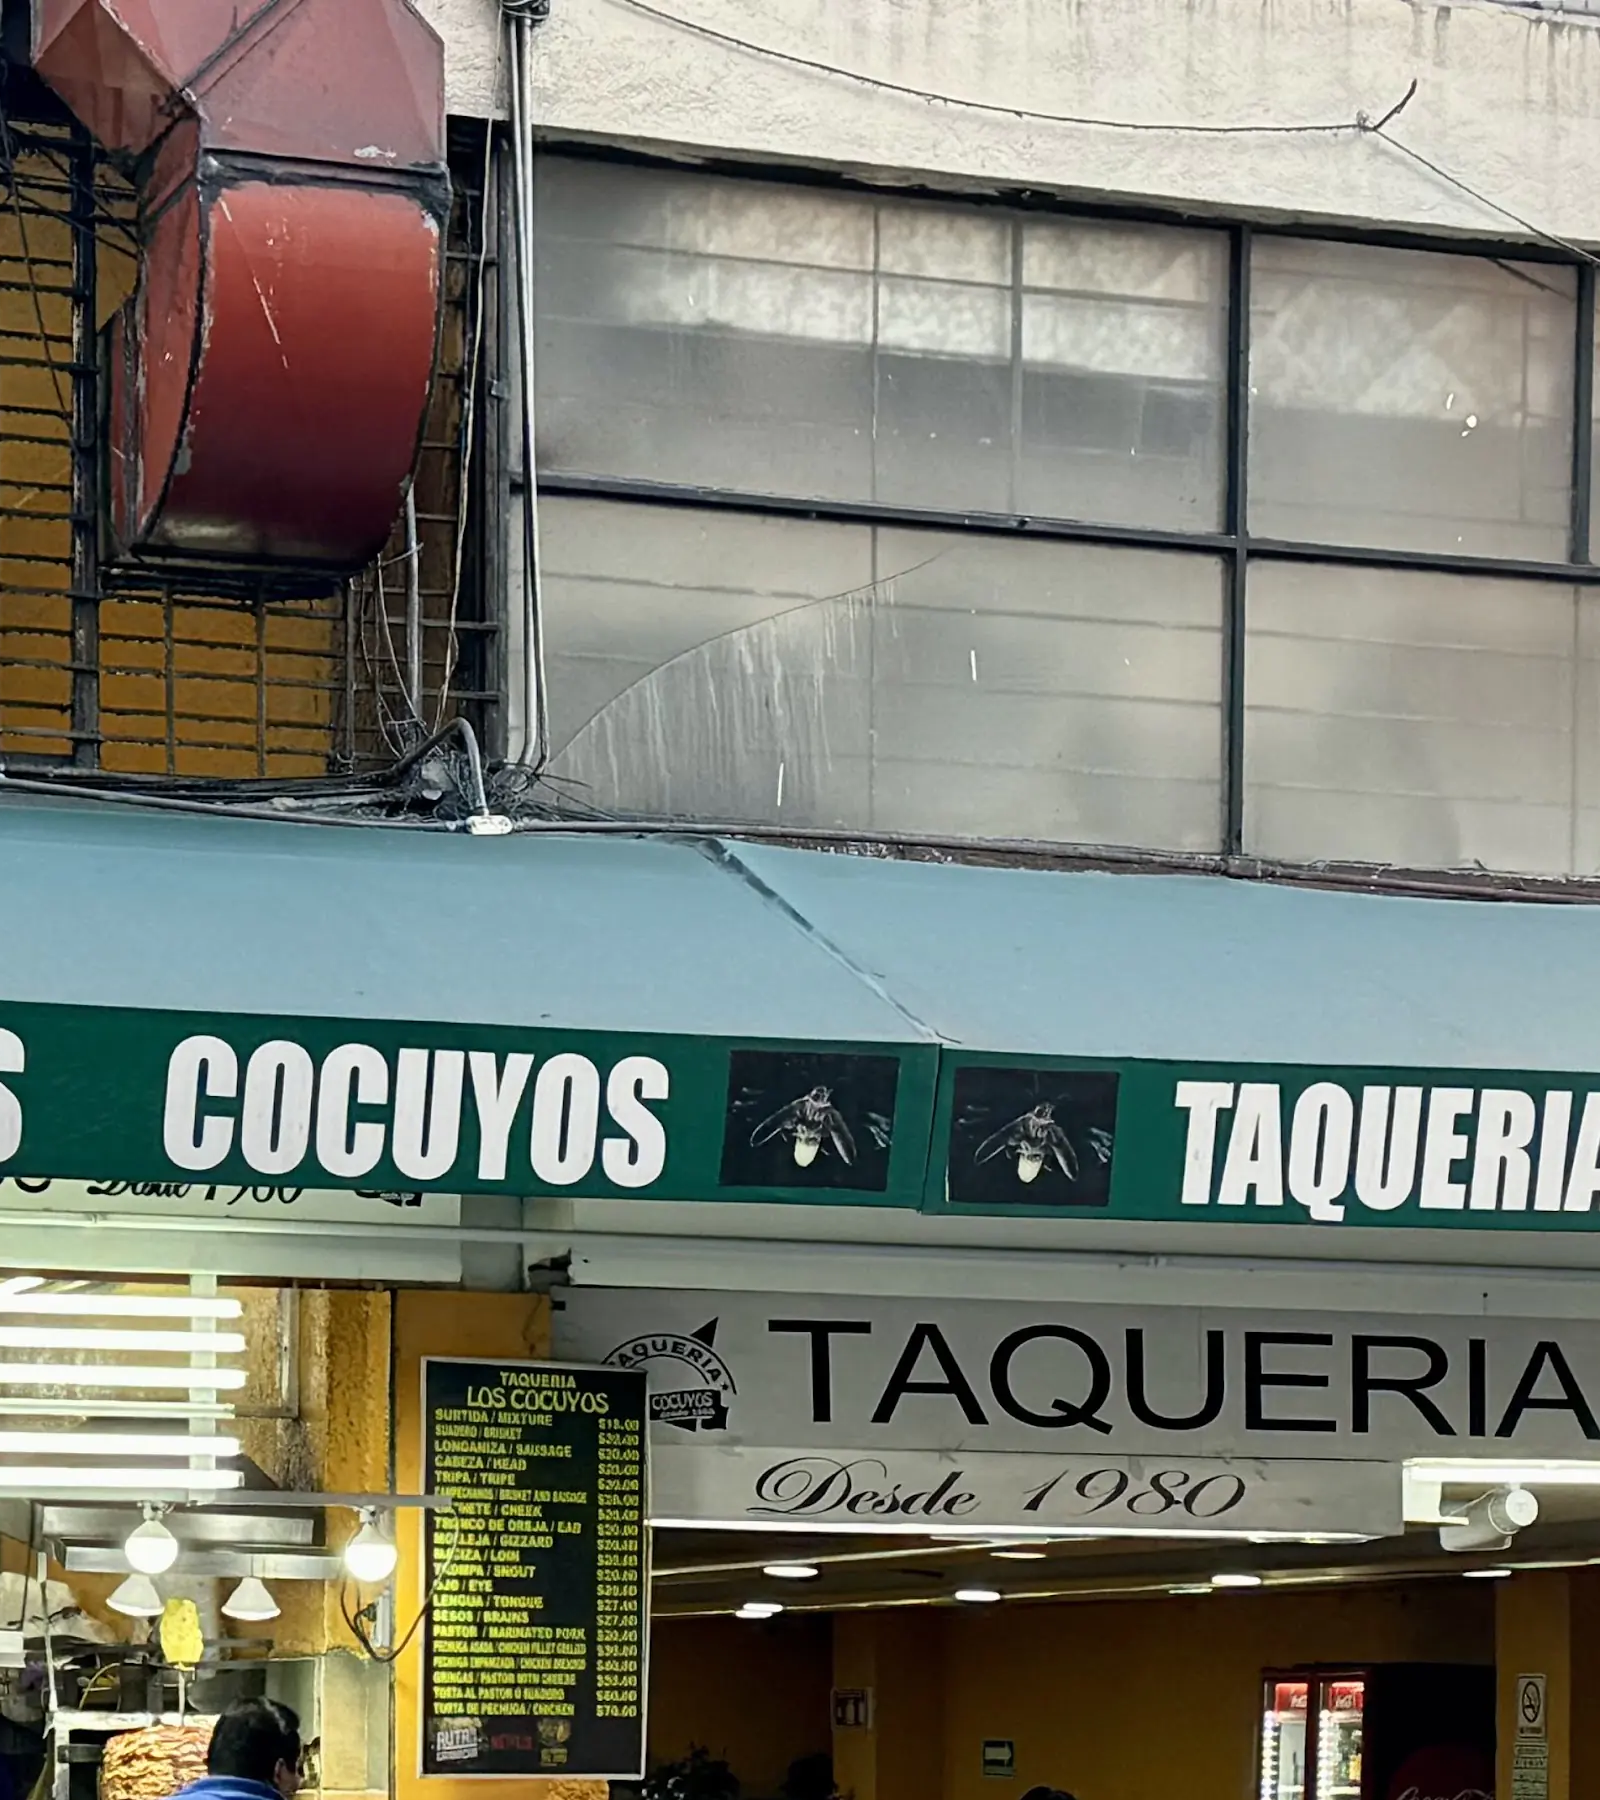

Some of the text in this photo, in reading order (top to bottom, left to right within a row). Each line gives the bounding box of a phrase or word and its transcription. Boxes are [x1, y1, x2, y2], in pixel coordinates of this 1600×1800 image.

[162, 1034, 669, 1188] COCUYOS
[608, 1339, 722, 1382] AQUERIA
[500, 1371, 576, 1388] TAQUERIA
[467, 1386, 609, 1414] LOS COCUYOS
[652, 1392, 713, 1410] COCUYOS
[752, 1457, 1246, 1519] Desde 1980
